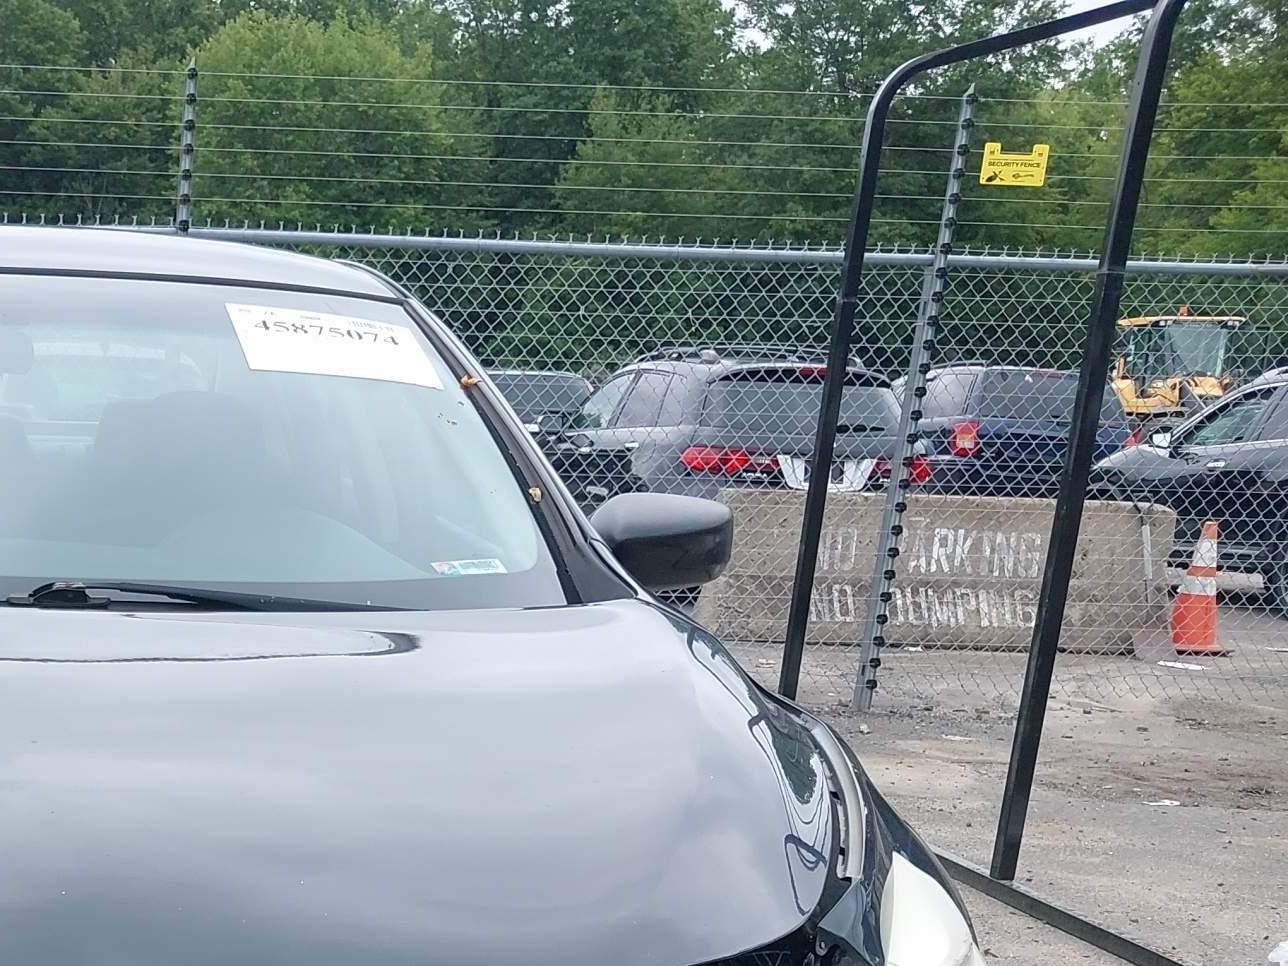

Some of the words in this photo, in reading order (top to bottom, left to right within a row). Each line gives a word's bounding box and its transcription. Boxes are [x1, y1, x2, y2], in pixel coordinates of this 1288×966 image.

[254, 319, 400, 346] 45875074
[817, 527, 858, 571] NO
[810, 583, 856, 622] NO
[886, 586, 1040, 628] DUMPING
